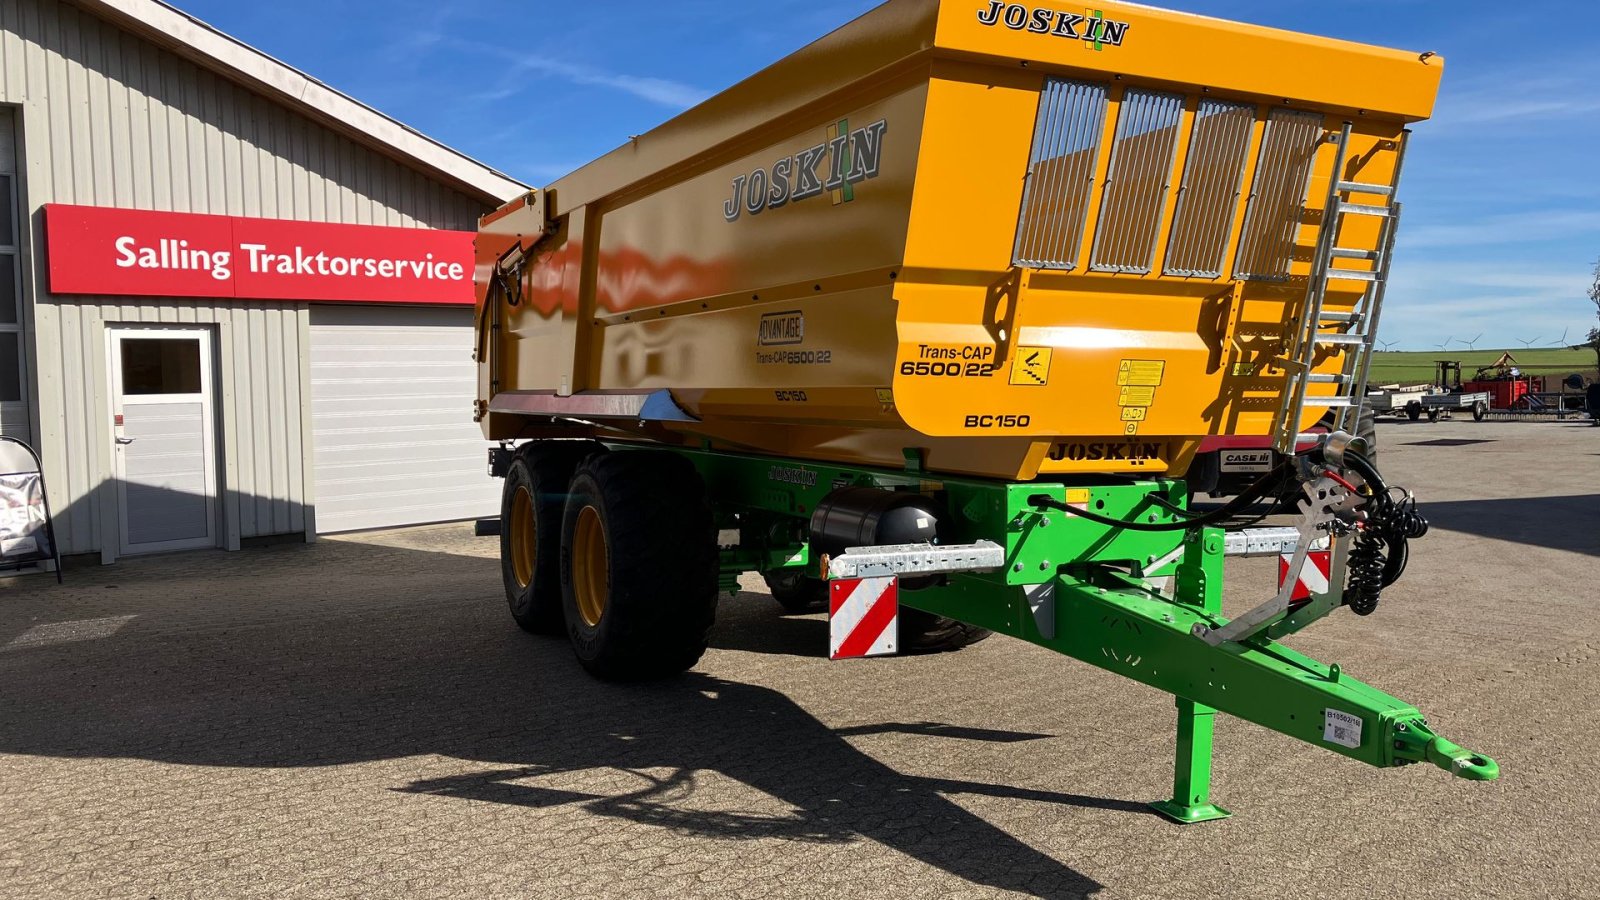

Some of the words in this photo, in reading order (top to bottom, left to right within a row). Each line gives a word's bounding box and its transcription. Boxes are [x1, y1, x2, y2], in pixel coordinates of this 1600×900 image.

[977, 0, 1129, 46] JOSKIN
[724, 119, 887, 222] JOSKIN
[115, 236, 231, 280] Salling
[240, 243, 463, 281] Traktorservice
[757, 316, 800, 346] ADVANTAGE
[919, 344, 992, 360] Trans-CAP
[900, 361, 994, 378] 6500/22
[775, 390, 807, 401] BC150
[964, 415, 1030, 428] BC150
[1049, 442, 1161, 461] JOSKIN
[1226, 454, 1257, 462] CASE
[768, 465, 817, 486] JOSKIN
